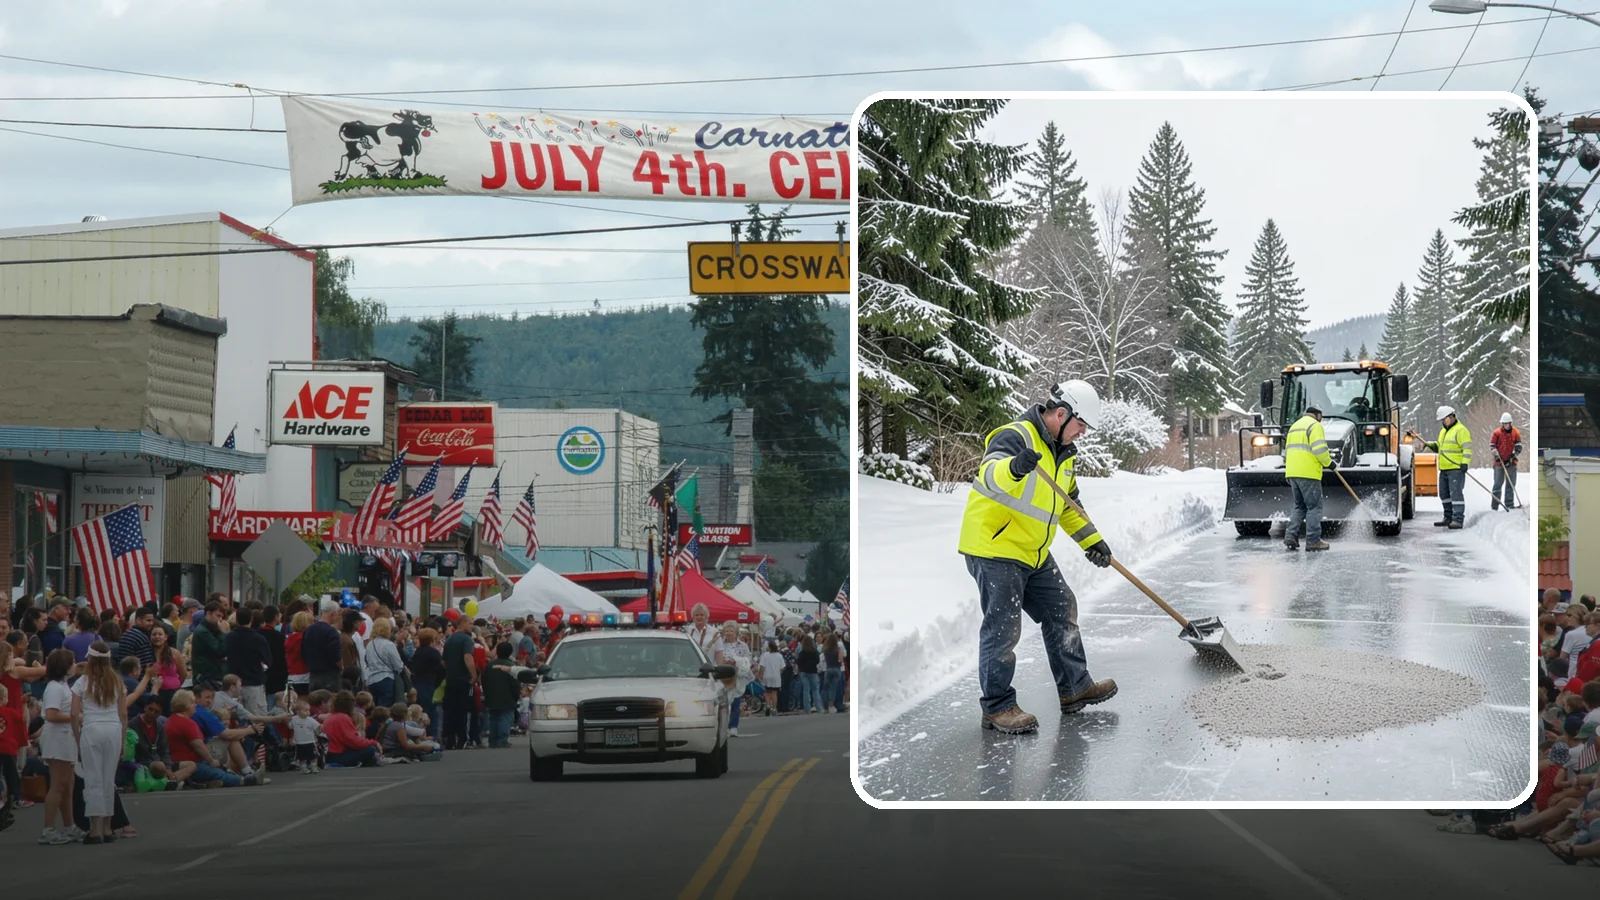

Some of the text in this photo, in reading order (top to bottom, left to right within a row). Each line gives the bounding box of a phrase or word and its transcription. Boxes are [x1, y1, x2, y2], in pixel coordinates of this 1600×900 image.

[695, 121, 850, 149] Carnat
[481, 141, 604, 192] JULY
[632, 150, 746, 198] 4th.
[697, 254, 850, 280] CROSSWA
[282, 380, 373, 420] ACE
[406, 409, 485, 421] CEDAR LOG
[283, 421, 370, 436] Hardware
[353, 467, 384, 479] Simpl
[83, 485, 155, 495] St. Vincent de Paul
[688, 526, 741, 535] CRNATION
[699, 535, 730, 543] GLASS
